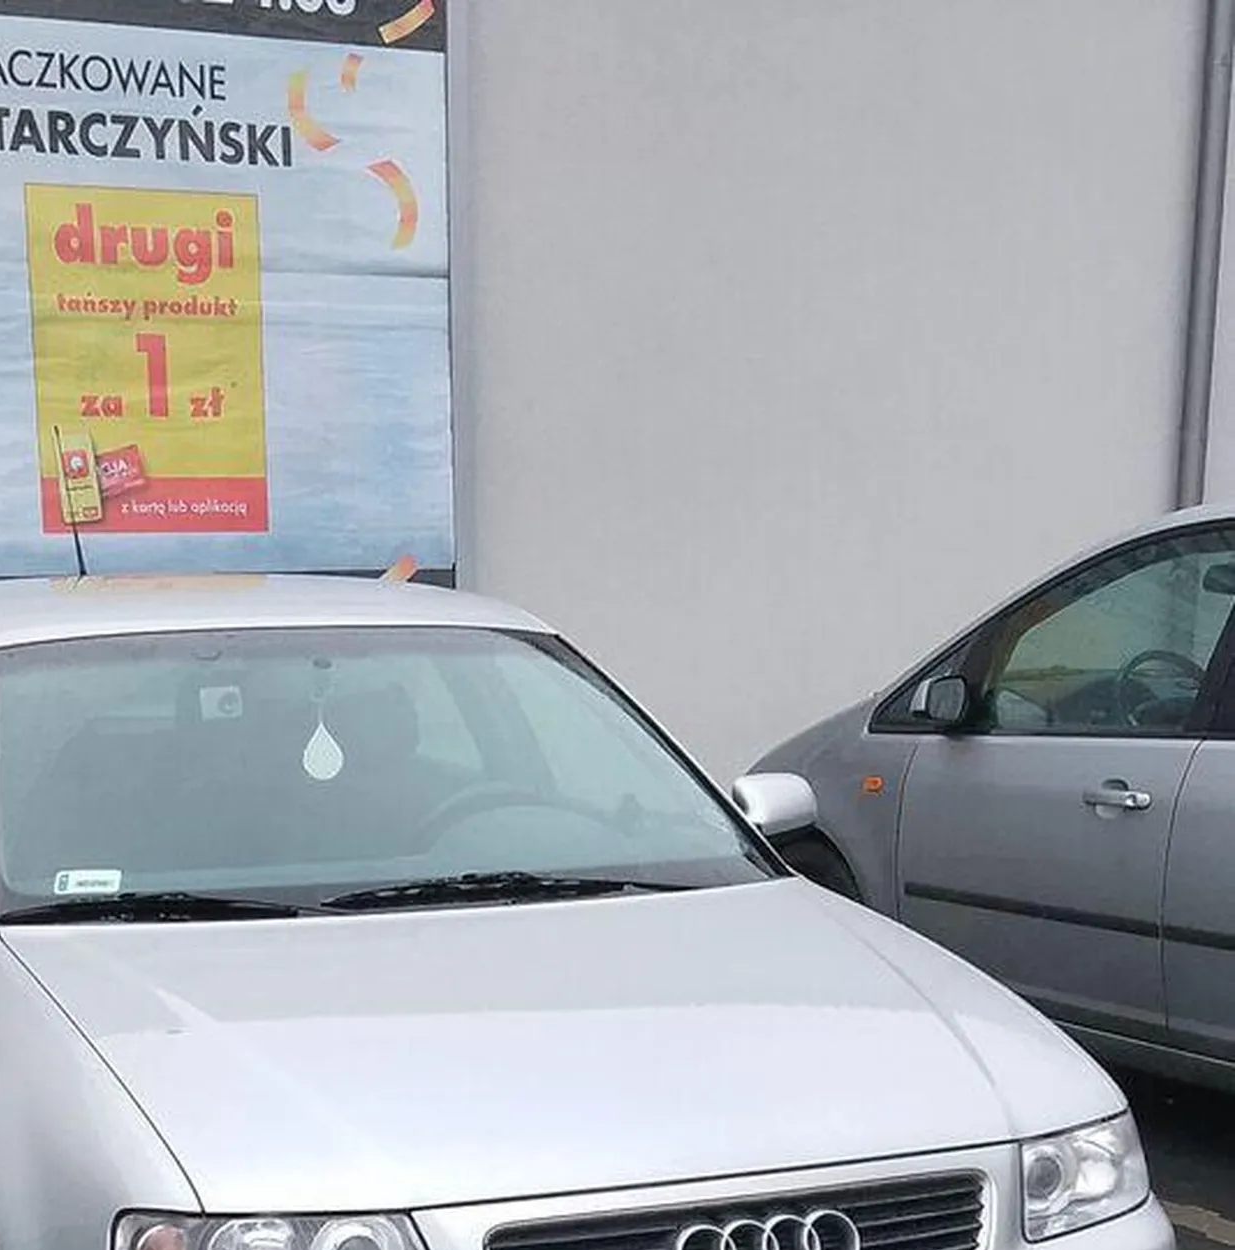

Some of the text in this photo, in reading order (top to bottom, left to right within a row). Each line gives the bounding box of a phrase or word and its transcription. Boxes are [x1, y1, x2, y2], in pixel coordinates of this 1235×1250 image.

[54, 203, 234, 284] drugi
[142, 296, 239, 321] produkt
[80, 333, 225, 417] za 1 zł
[168, 500, 188, 513] lub
